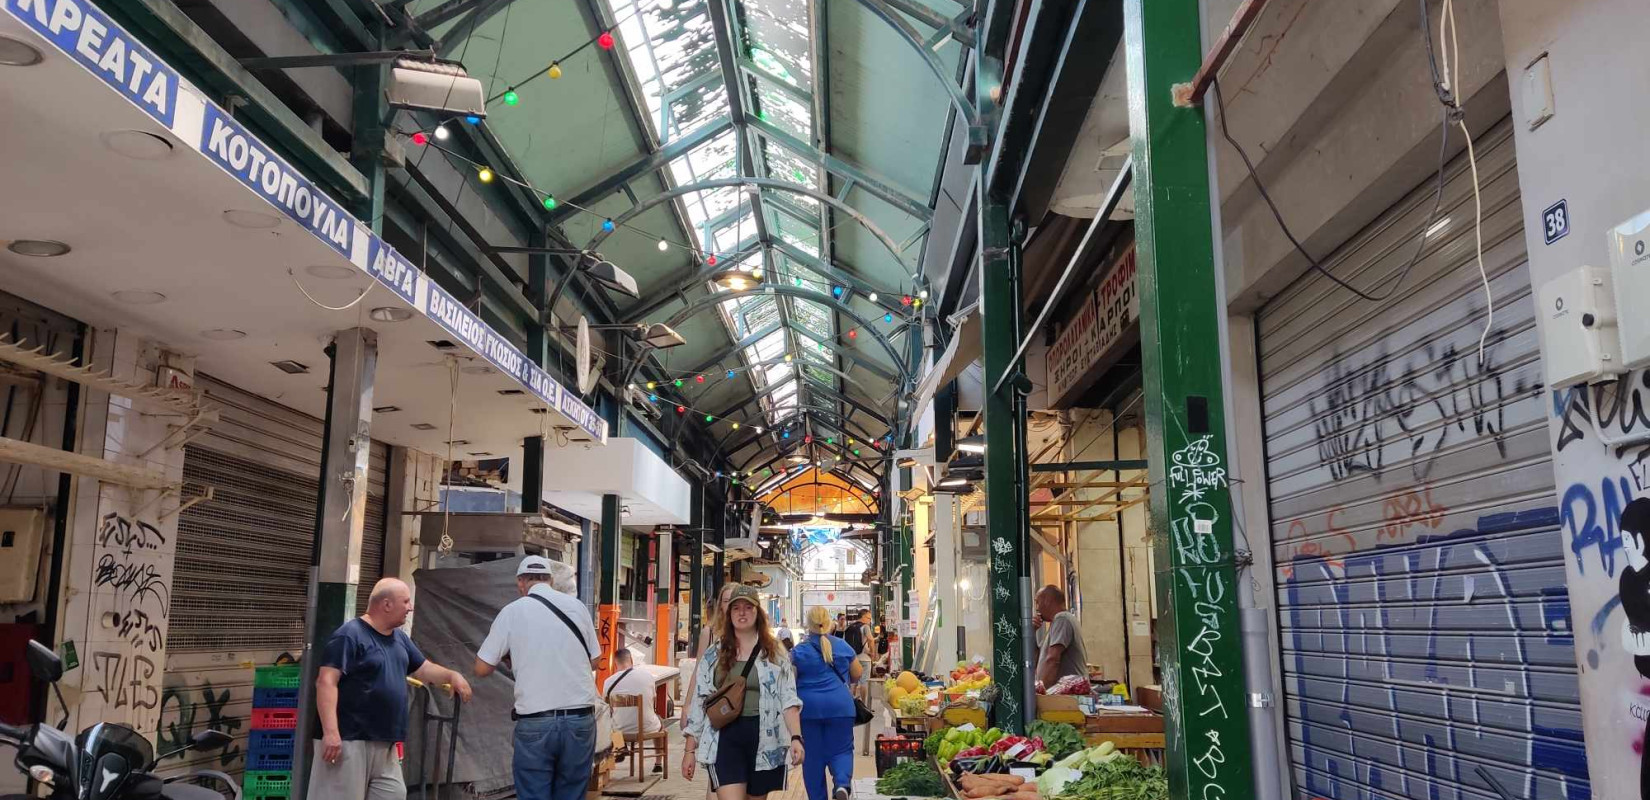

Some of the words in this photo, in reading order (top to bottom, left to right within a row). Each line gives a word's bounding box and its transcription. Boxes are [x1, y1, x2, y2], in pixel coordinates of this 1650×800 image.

[208, 117, 348, 250] ΚΟΤΟΠΟΥΛΑ
[1546, 208, 1565, 237] 38
[372, 247, 413, 297] ΑΒΓΑ
[1101, 246, 1136, 310] ΤΡΟΦΙΜ
[429, 288, 485, 351] ΒΑΣΙΛΕΙΟΣ
[485, 333, 523, 378] ΓΚΟΣΙΟΣ
[522, 362, 529, 383] &
[529, 367, 542, 393] ΣΙΑ
[1090, 281, 1135, 342] ΚΑΡΠΟΙ
[1192, 466, 1227, 491] POWER
